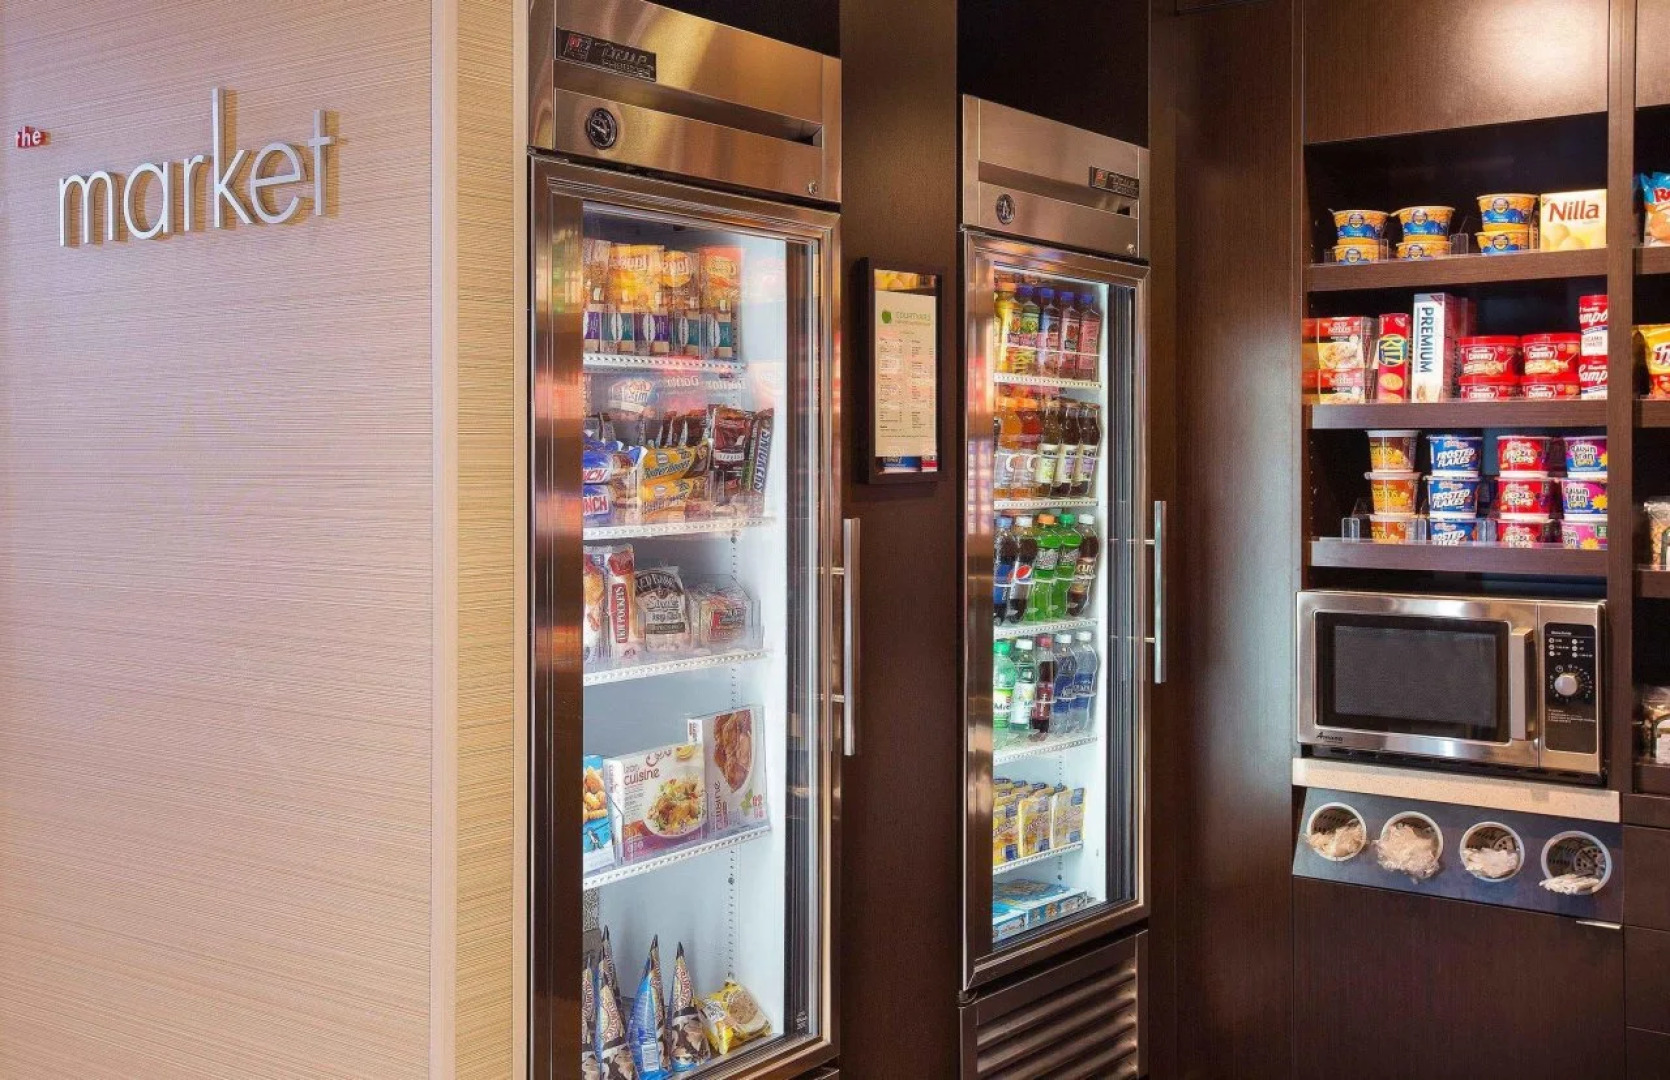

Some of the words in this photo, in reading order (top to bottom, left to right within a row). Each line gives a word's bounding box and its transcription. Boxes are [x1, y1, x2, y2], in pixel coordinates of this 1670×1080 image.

[15, 126, 42, 148] the
[59, 87, 336, 247] market
[1548, 200, 1600, 223] Nilla
[1380, 337, 1403, 365] RITZ
[1420, 307, 1435, 373] PREMIUM
[753, 426, 771, 492] SNICKERS
[1437, 448, 1475, 461] FROSTED
[1438, 457, 1470, 468] FLAKES
[1433, 489, 1471, 501] FROSTED
[1434, 498, 1465, 509] FLAKES
[624, 768, 660, 786] cuisine
